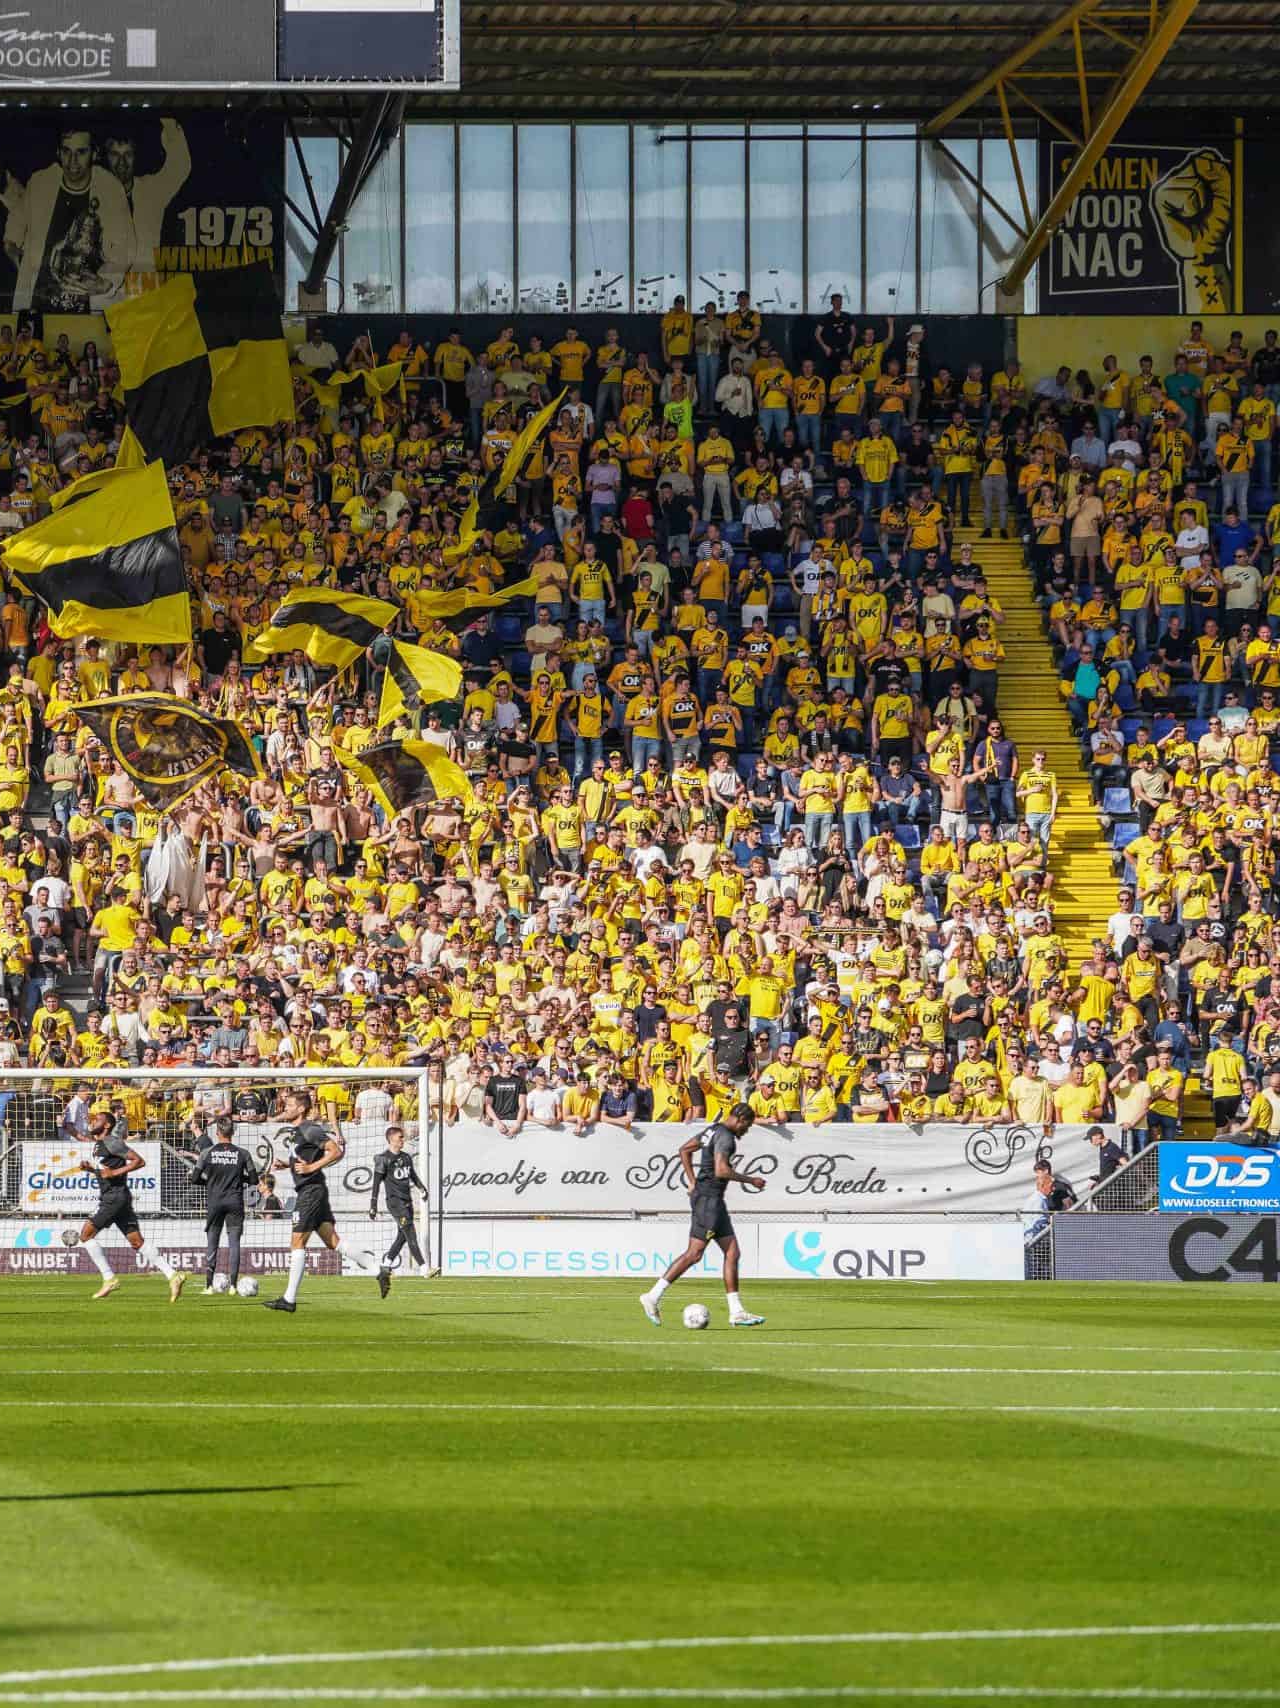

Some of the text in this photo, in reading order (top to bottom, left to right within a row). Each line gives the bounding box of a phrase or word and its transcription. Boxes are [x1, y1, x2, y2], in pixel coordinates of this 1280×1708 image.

[1064, 195, 1142, 228] VOOR
[178, 206, 274, 246] 1973
[1060, 232, 1143, 278] NAC
[800, 392, 816, 400] OK
[632, 416, 649, 425] OK
[398, 582, 414, 590] OK
[859, 608, 877, 617] OK
[750, 643, 769, 652] OK
[623, 675, 640, 686] OK
[676, 702, 693, 711] OK
[640, 708, 656, 717] OK
[467, 741, 484, 750] OK
[559, 821, 576, 829] OK
[631, 821, 647, 830] OK
[1244, 819, 1264, 828] OK
[274, 885, 294, 893] OK
[890, 899, 905, 908] OK
[842, 960, 860, 968] OK
[1216, 1004, 1236, 1012] CM
[965, 1077, 984, 1085] OK
[779, 1082, 799, 1090] OK
[393, 1166, 412, 1180] OK
[1184, 1155, 1275, 1188] DDS
[28, 1171, 157, 1191] Gloudeans
[561, 1168, 610, 1187] van
[9, 1253, 79, 1269] UNIBET
[448, 1250, 730, 1273] PROFESSIONL
[832, 1249, 926, 1279] QNP
